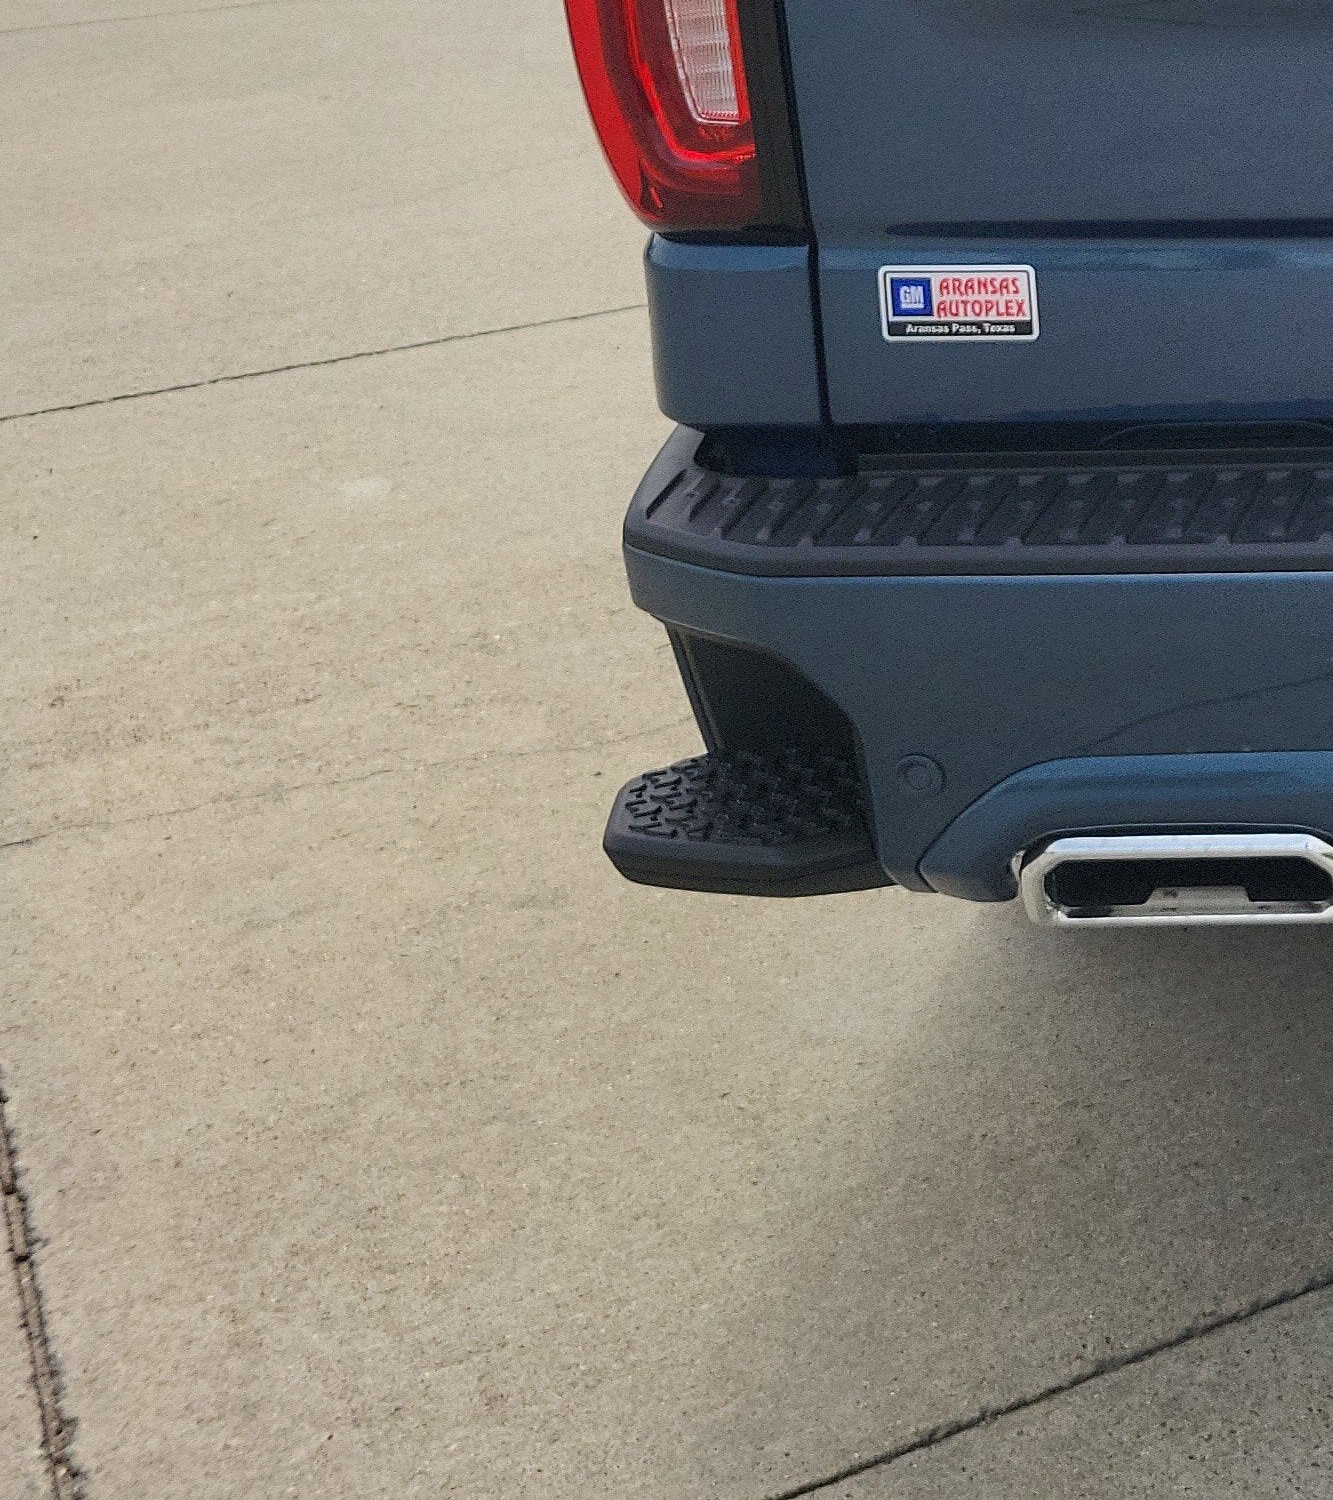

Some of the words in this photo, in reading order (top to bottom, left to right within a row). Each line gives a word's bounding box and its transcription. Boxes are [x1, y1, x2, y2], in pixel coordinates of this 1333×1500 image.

[900, 285, 924, 306] GM
[939, 277, 1021, 297] ARANSAS
[936, 299, 1026, 318] AUTOPLEX
[906, 323, 950, 335] Aransas
[952, 323, 982, 335] Pass,
[984, 322, 1016, 334] Texas
